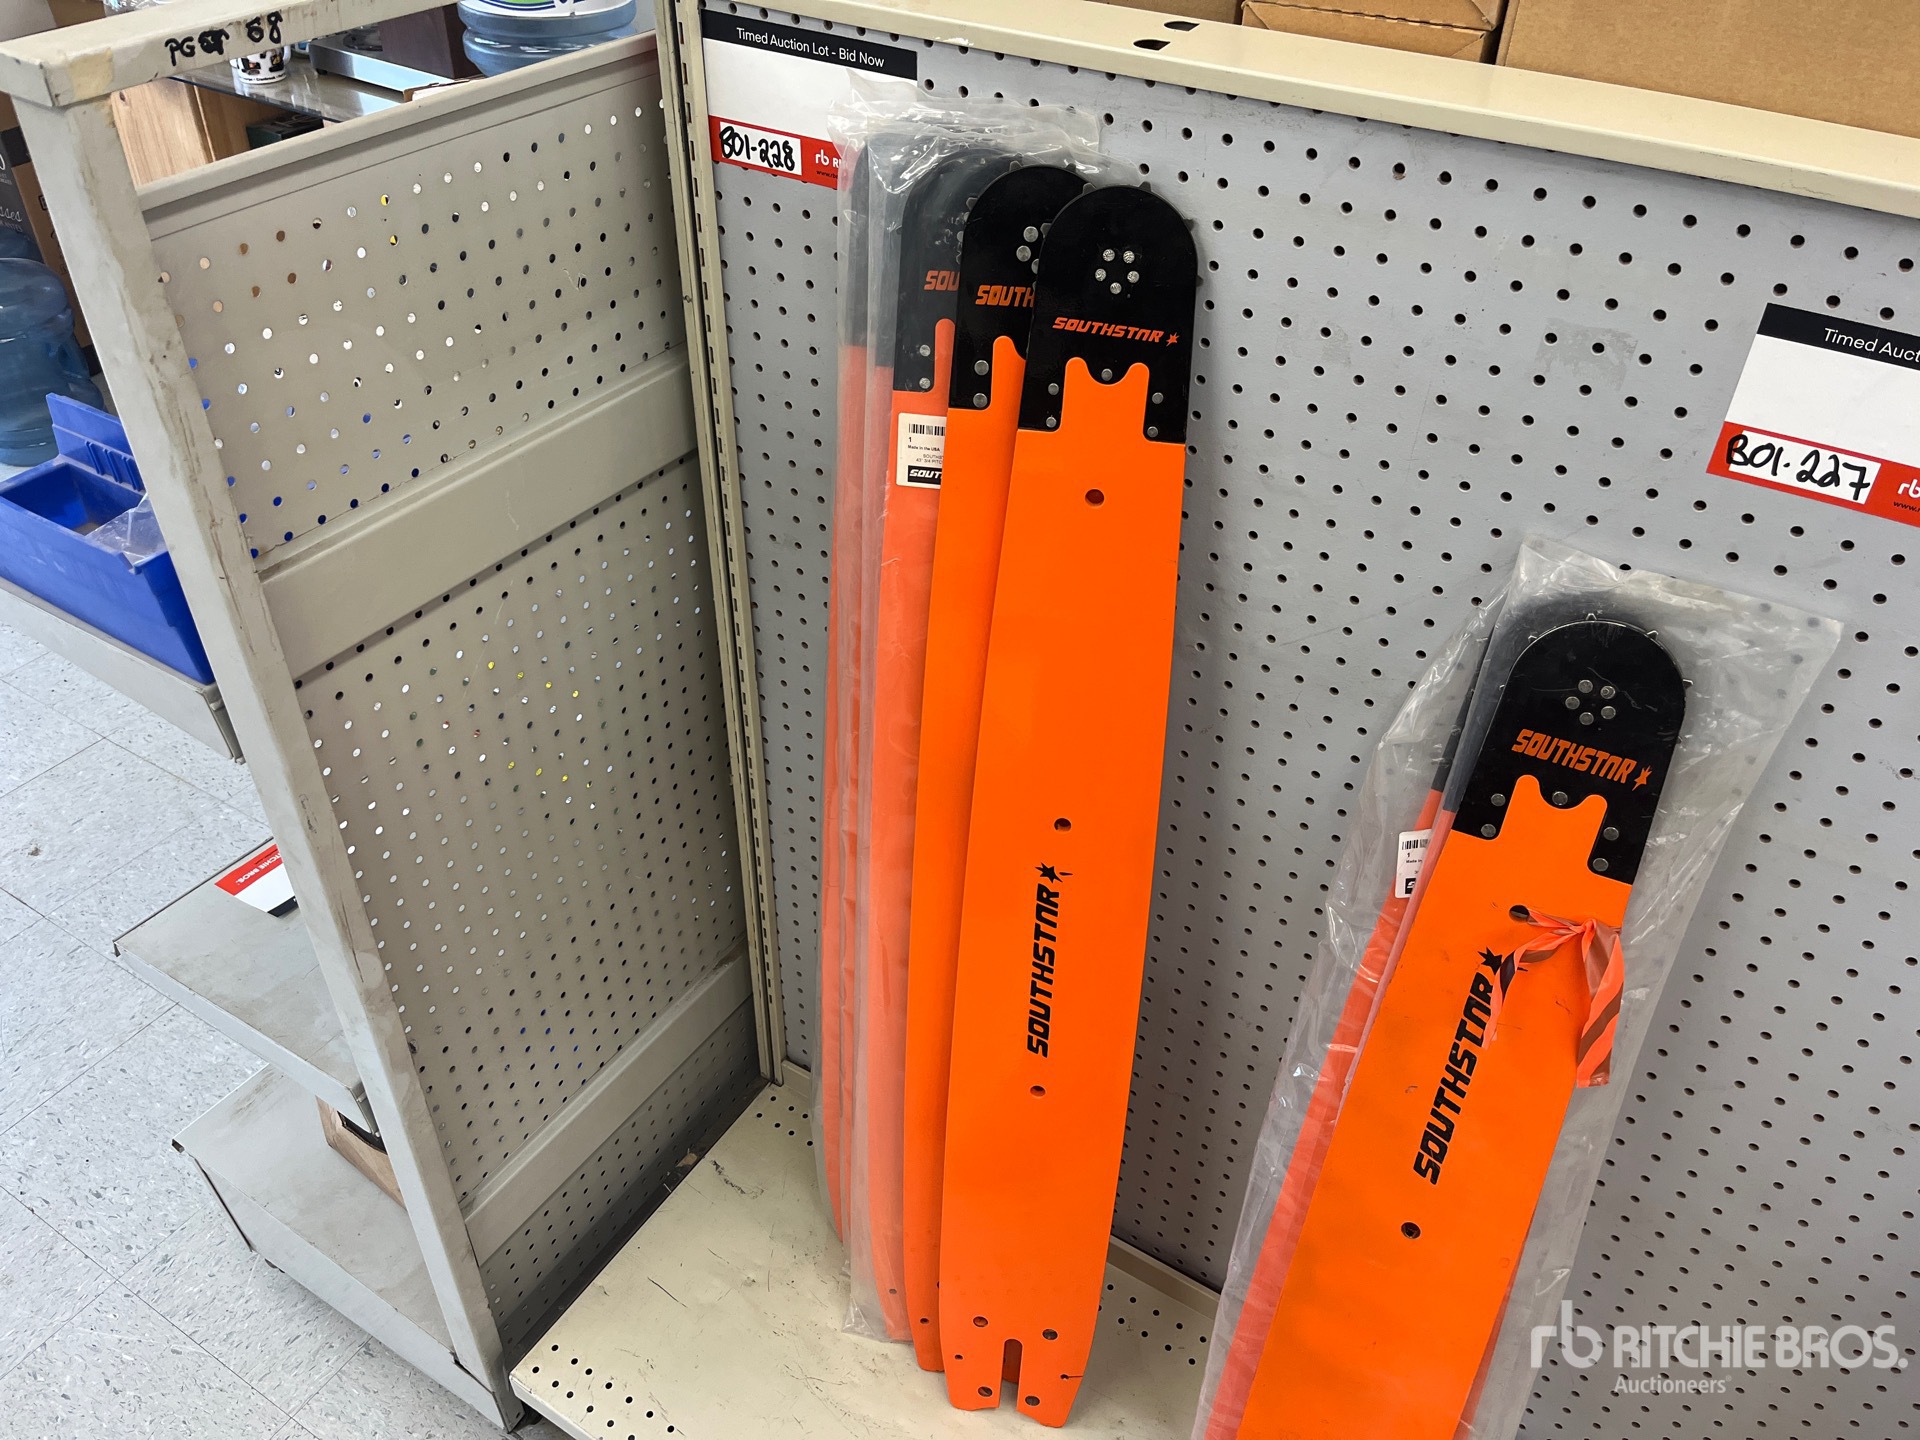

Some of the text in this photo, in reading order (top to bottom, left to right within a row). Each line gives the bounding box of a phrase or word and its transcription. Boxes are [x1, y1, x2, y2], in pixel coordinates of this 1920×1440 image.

[736, 27, 768, 45] Timed
[769, 34, 809, 53] Auction
[812, 42, 829, 57] Lot
[839, 48, 856, 62] Bid
[859, 52, 885, 68] Now
[815, 149, 830, 166] rb
[1052, 316, 1165, 343] SOUTHSTAR
[1824, 327, 1878, 352] Timed
[909, 468, 942, 479] SOUT
[1511, 728, 1638, 784] SOUTHSTAR
[1026, 883, 1060, 1059] SOUTHSTAR
[1412, 971, 1495, 1185] SOUTHSTAR
